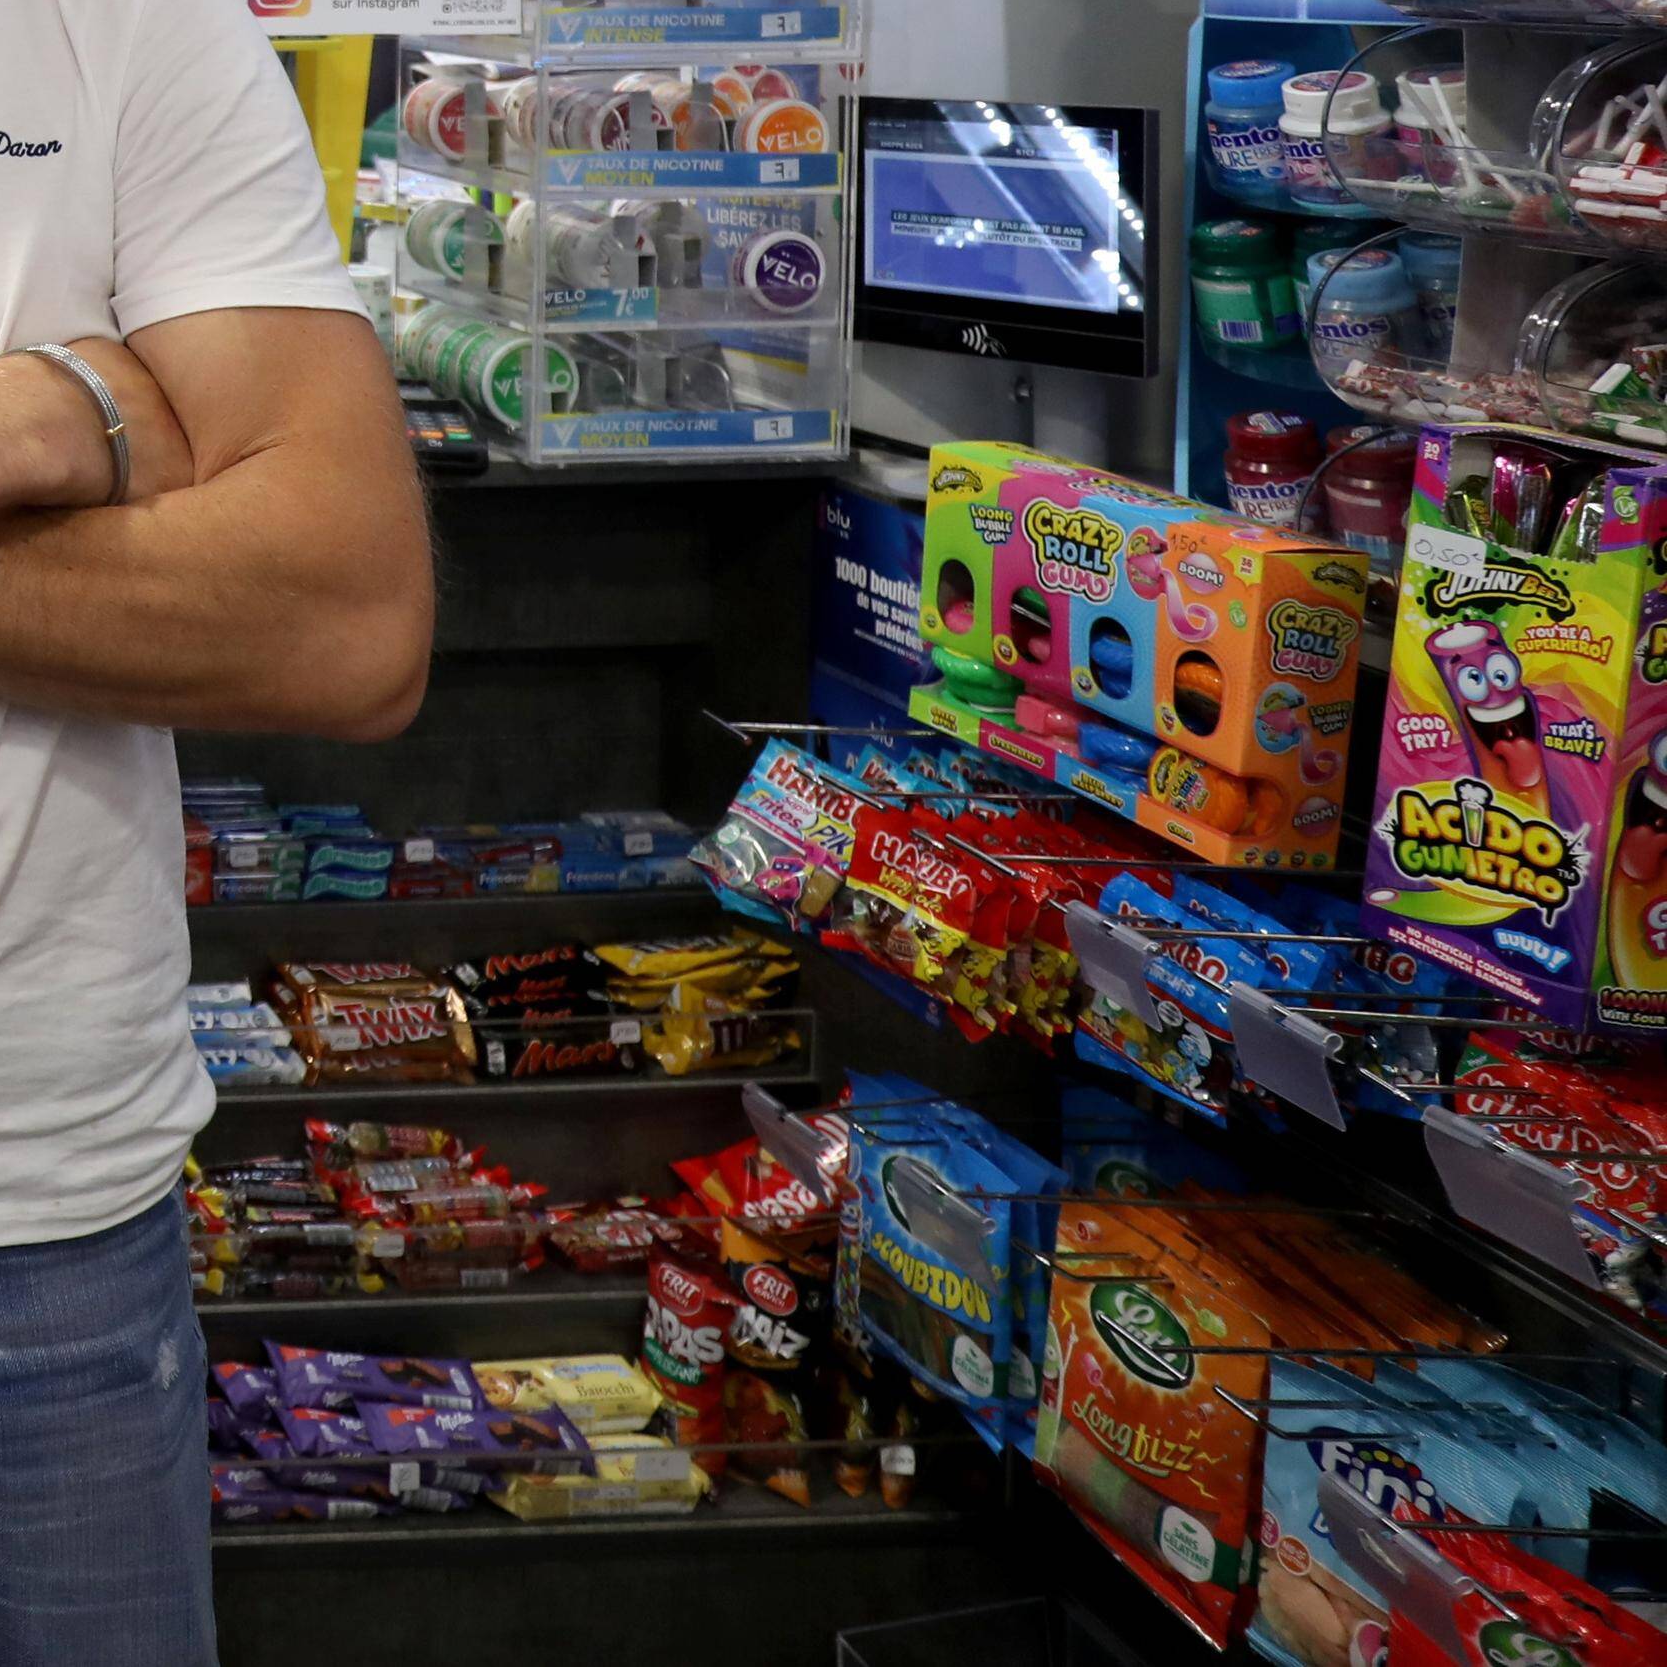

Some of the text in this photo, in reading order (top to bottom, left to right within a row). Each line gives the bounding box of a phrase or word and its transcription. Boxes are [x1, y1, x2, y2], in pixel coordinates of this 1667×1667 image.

[706, 207, 802, 231] LIBÉREZ LES
[1423, 441, 1440, 454] 30
[970, 504, 1014, 523] LOONG
[974, 517, 1012, 533] BUBBLE
[1030, 502, 1123, 551] CRAZY
[984, 530, 1007, 543] GUM
[1044, 536, 1110, 573] ROLL
[835, 556, 867, 582] 1000
[1178, 560, 1226, 588] BOOM!
[857, 591, 869, 610] de
[871, 599, 889, 619] vos
[875, 619, 924, 652] préférées
[1280, 609, 1357, 637] CRAZY
[1527, 625, 1590, 640] YOU'RE A
[1284, 630, 1339, 656] ROLL
[1517, 636, 1613, 664] SUPERHERO!
[1397, 715, 1447, 734] GOOD
[1550, 719, 1595, 738] THAT'S
[1544, 734, 1604, 761] BRAVE!
[1398, 839, 1565, 904] GUMETRO
[1406, 926, 1524, 987] NO ARTIFICIAL COLOURS
[1603, 1009, 1665, 1025] WITH SOUR
[512, 1039, 615, 1078] Mars
[660, 1268, 700, 1300] FRIT
[752, 1272, 792, 1301] FRIT
[871, 1231, 992, 1323] SCOUBIDOU
[434, 1412, 475, 1432] Milka
[1071, 1392, 1196, 1473] Longfizz
